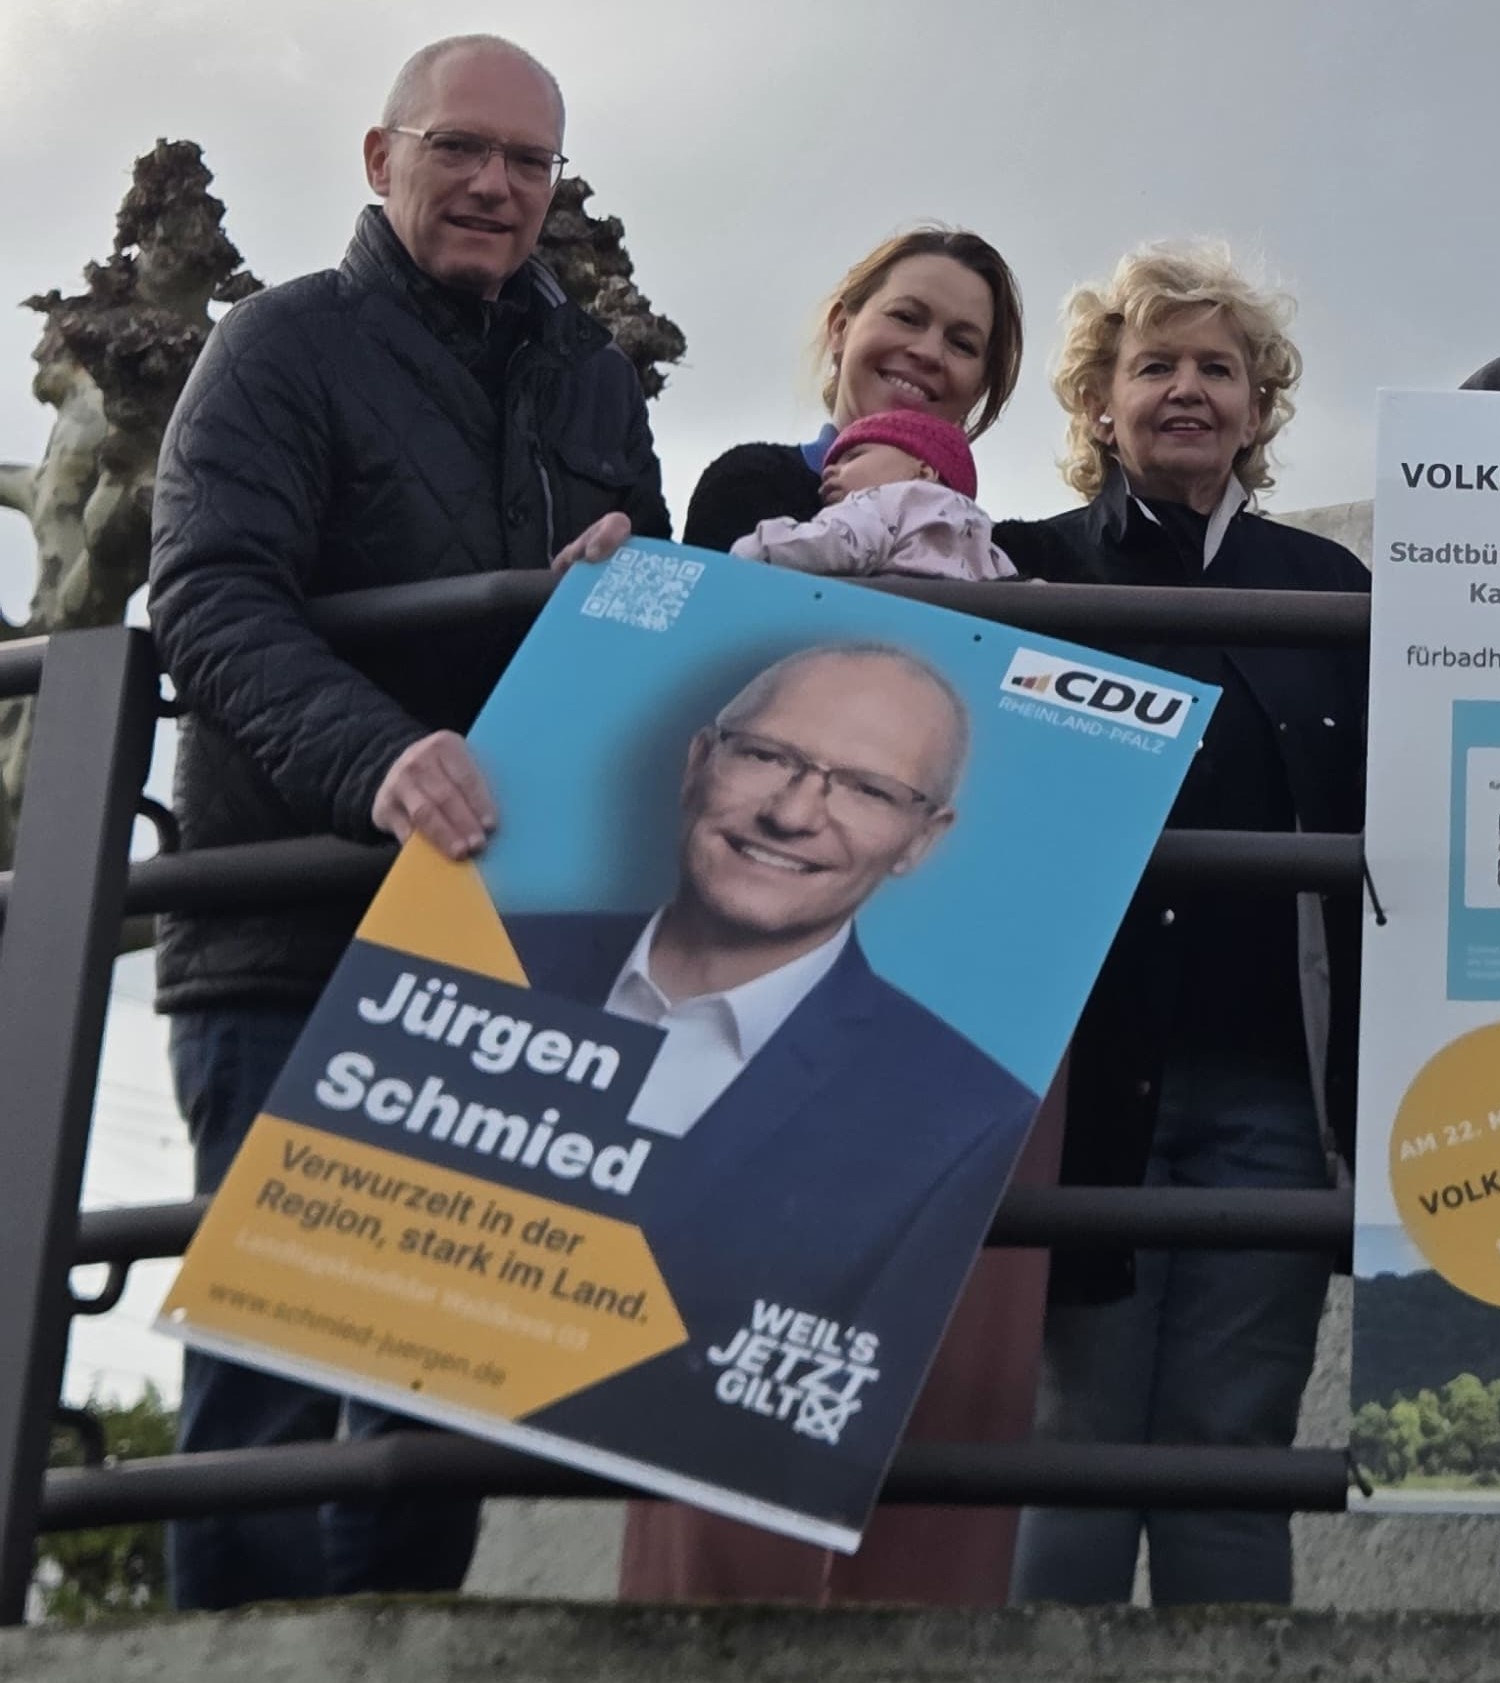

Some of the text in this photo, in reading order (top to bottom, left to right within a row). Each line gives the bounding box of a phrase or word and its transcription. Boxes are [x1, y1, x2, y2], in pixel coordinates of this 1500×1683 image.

[998, 696, 1166, 755] RHEINLAND-PFALZ
[1054, 671, 1183, 725] CDU
[357, 972, 621, 1091] Jürgen
[315, 1051, 652, 1196] Schmied
[1400, 1133, 1438, 1162] AM
[1443, 1121, 1482, 1146] 22.
[281, 1139, 585, 1257] Verwurzelt in der
[255, 1180, 650, 1324] Region, stark im Land.
[706, 1328, 880, 1400] JETZT
[715, 1369, 804, 1421] GILT
